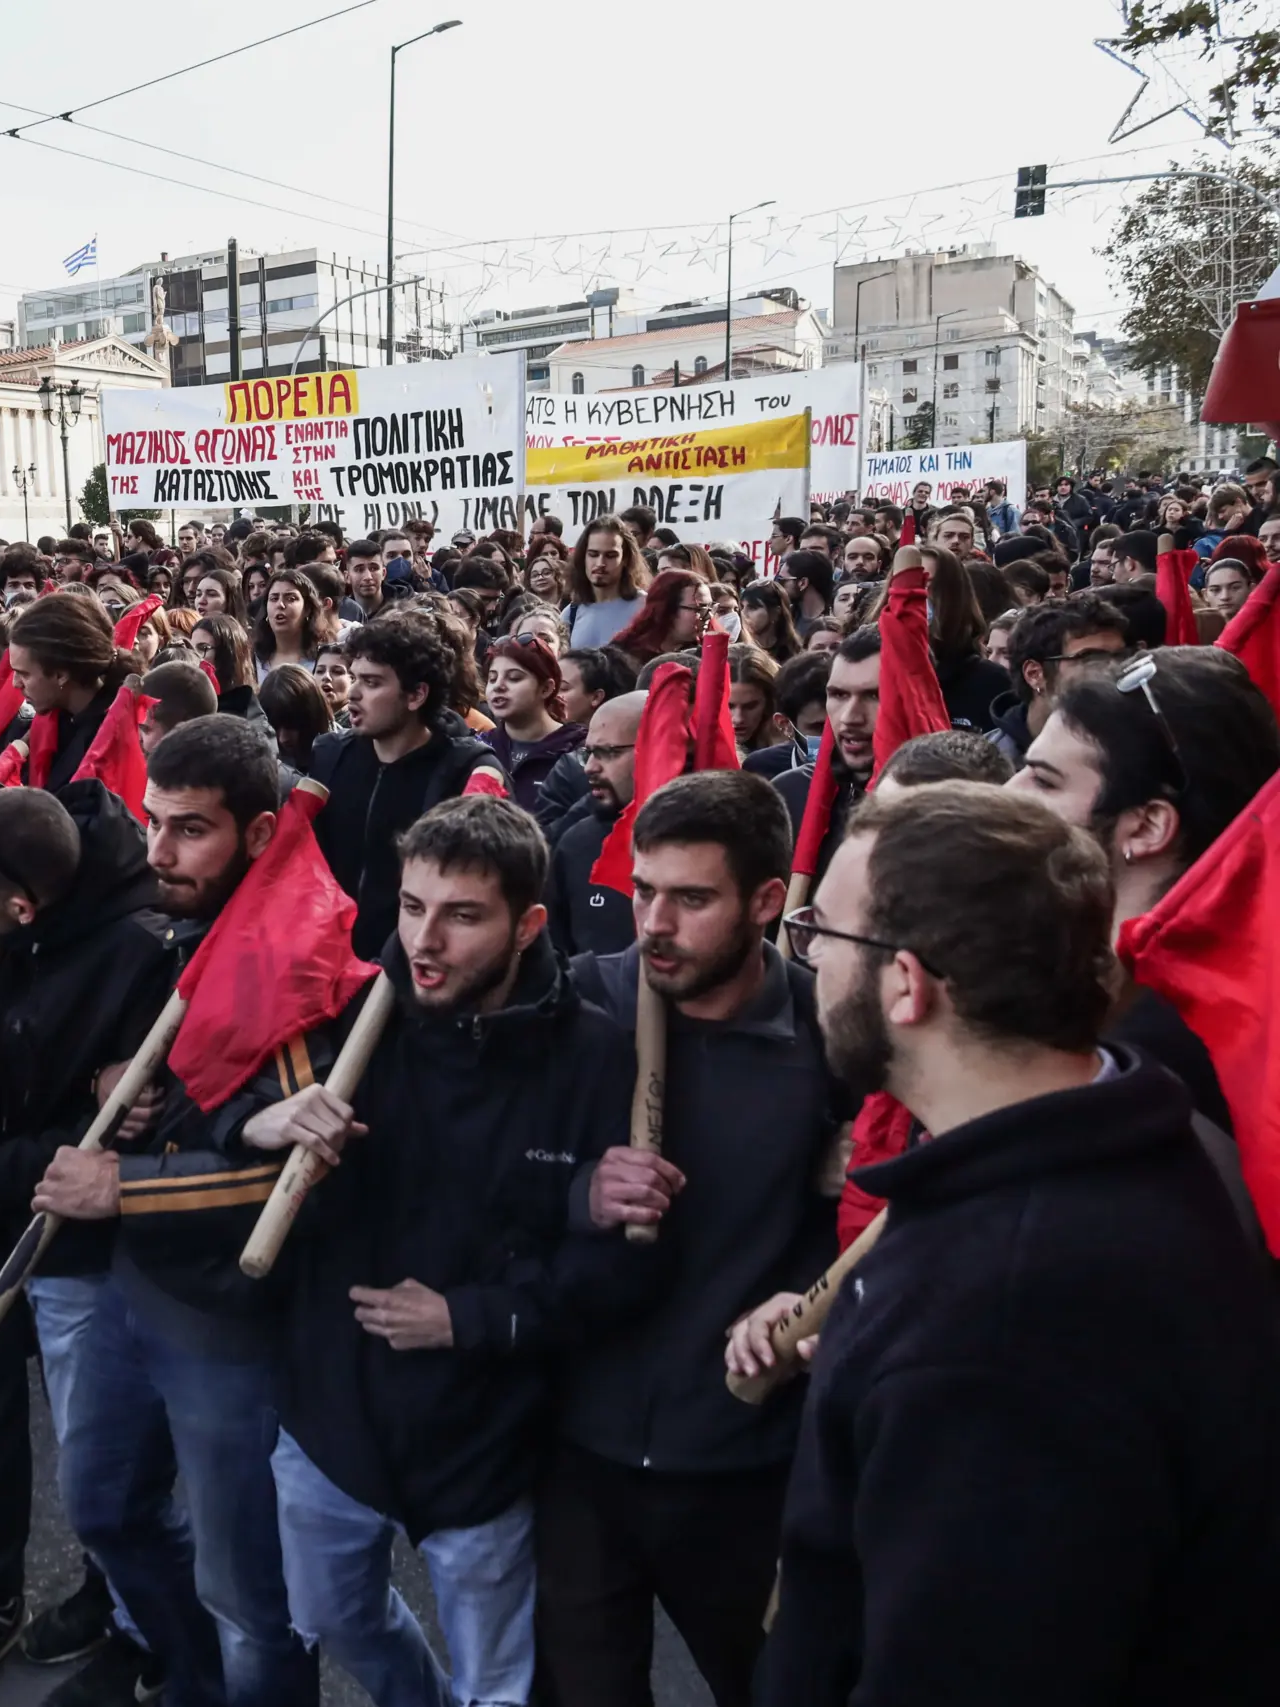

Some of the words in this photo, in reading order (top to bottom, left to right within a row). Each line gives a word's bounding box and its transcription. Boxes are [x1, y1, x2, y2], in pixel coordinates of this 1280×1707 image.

[230, 374, 352, 422] ΠΟΡΕΙΑ
[565, 400, 576, 423] Η
[588, 390, 734, 426] ΚΥΒΕΡΝΗΣΗ
[107, 429, 191, 465] ΜΑΖΙΚΟΣ
[195, 425, 277, 465] ΑΓΩΝΑΣ
[286, 420, 348, 445] ΕΝΑΝΤΙΑ
[353, 408, 464, 460] ΠΟΛΙΤΙΚΗ
[586, 433, 696, 460] ΜΑΘΗΤΙΚΗ
[293, 445, 335, 464] ΣΤΗΝ
[628, 446, 745, 473] ΑΝΤΙΣΤΑΣΗ
[920, 454, 939, 472] ΚΑΙ
[947, 451, 972, 470] ΤΗΝ
[111, 476, 138, 494] ΤΗΣ
[154, 469, 278, 502] ΚΑΤΑΣΤΟΛΗΣ
[292, 469, 319, 487] ΚΑΙ
[330, 450, 513, 497] ΤΡΟΜΟΚΡΑΤΙΑΣ
[294, 488, 324, 500] ΤΗΣ
[567, 488, 616, 526] ΤΟΝ
